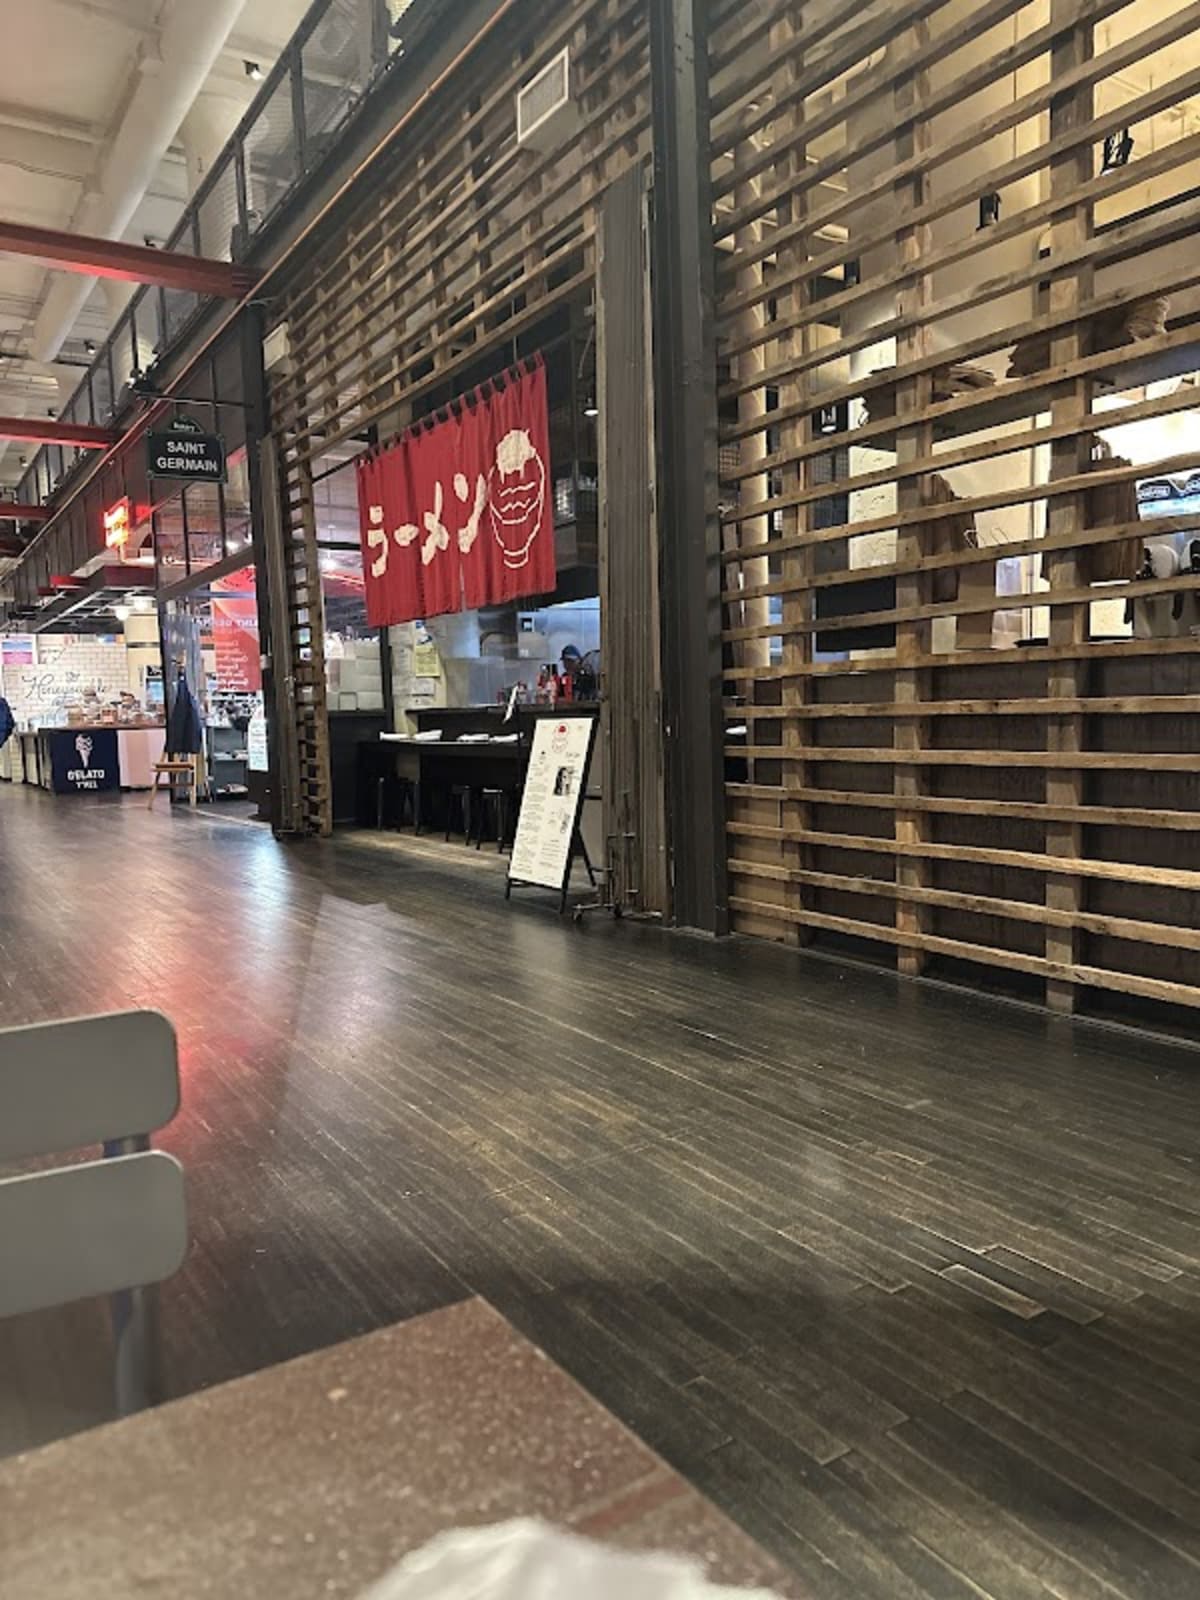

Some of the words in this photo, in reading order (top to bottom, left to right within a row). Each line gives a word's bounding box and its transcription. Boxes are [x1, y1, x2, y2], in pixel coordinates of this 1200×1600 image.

[167, 441, 207, 455] SAINT
[156, 456, 218, 472] GERMAIN
[367, 472, 487, 579] ラーメン
[67, 769, 105, 781] GELATO
